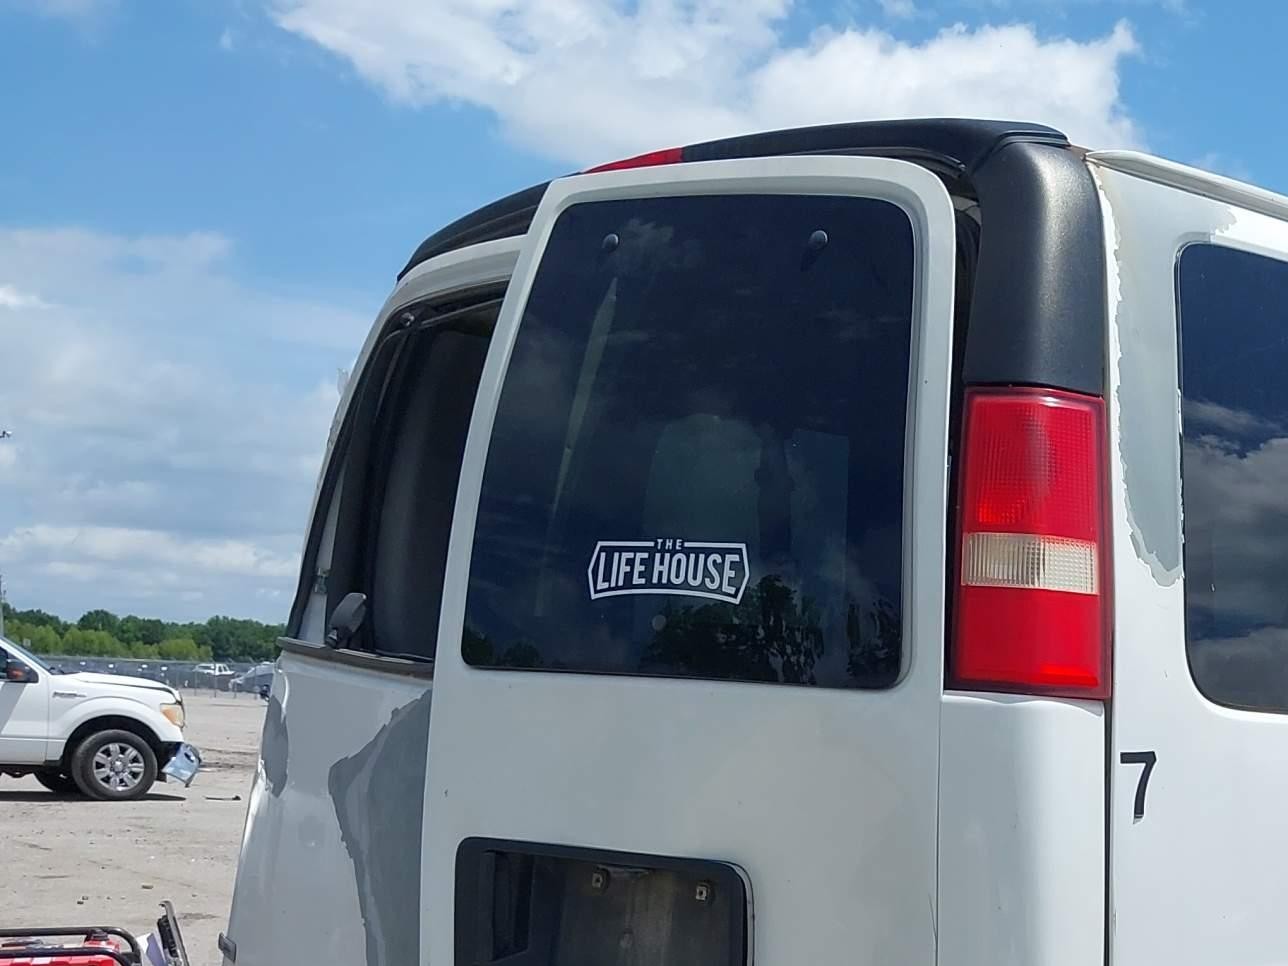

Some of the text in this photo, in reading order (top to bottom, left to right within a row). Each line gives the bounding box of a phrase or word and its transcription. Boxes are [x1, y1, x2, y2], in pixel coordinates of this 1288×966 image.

[656, 538, 683, 550] THE
[596, 552, 741, 595] LIFE HOUSE
[1119, 751, 1157, 824] 7
